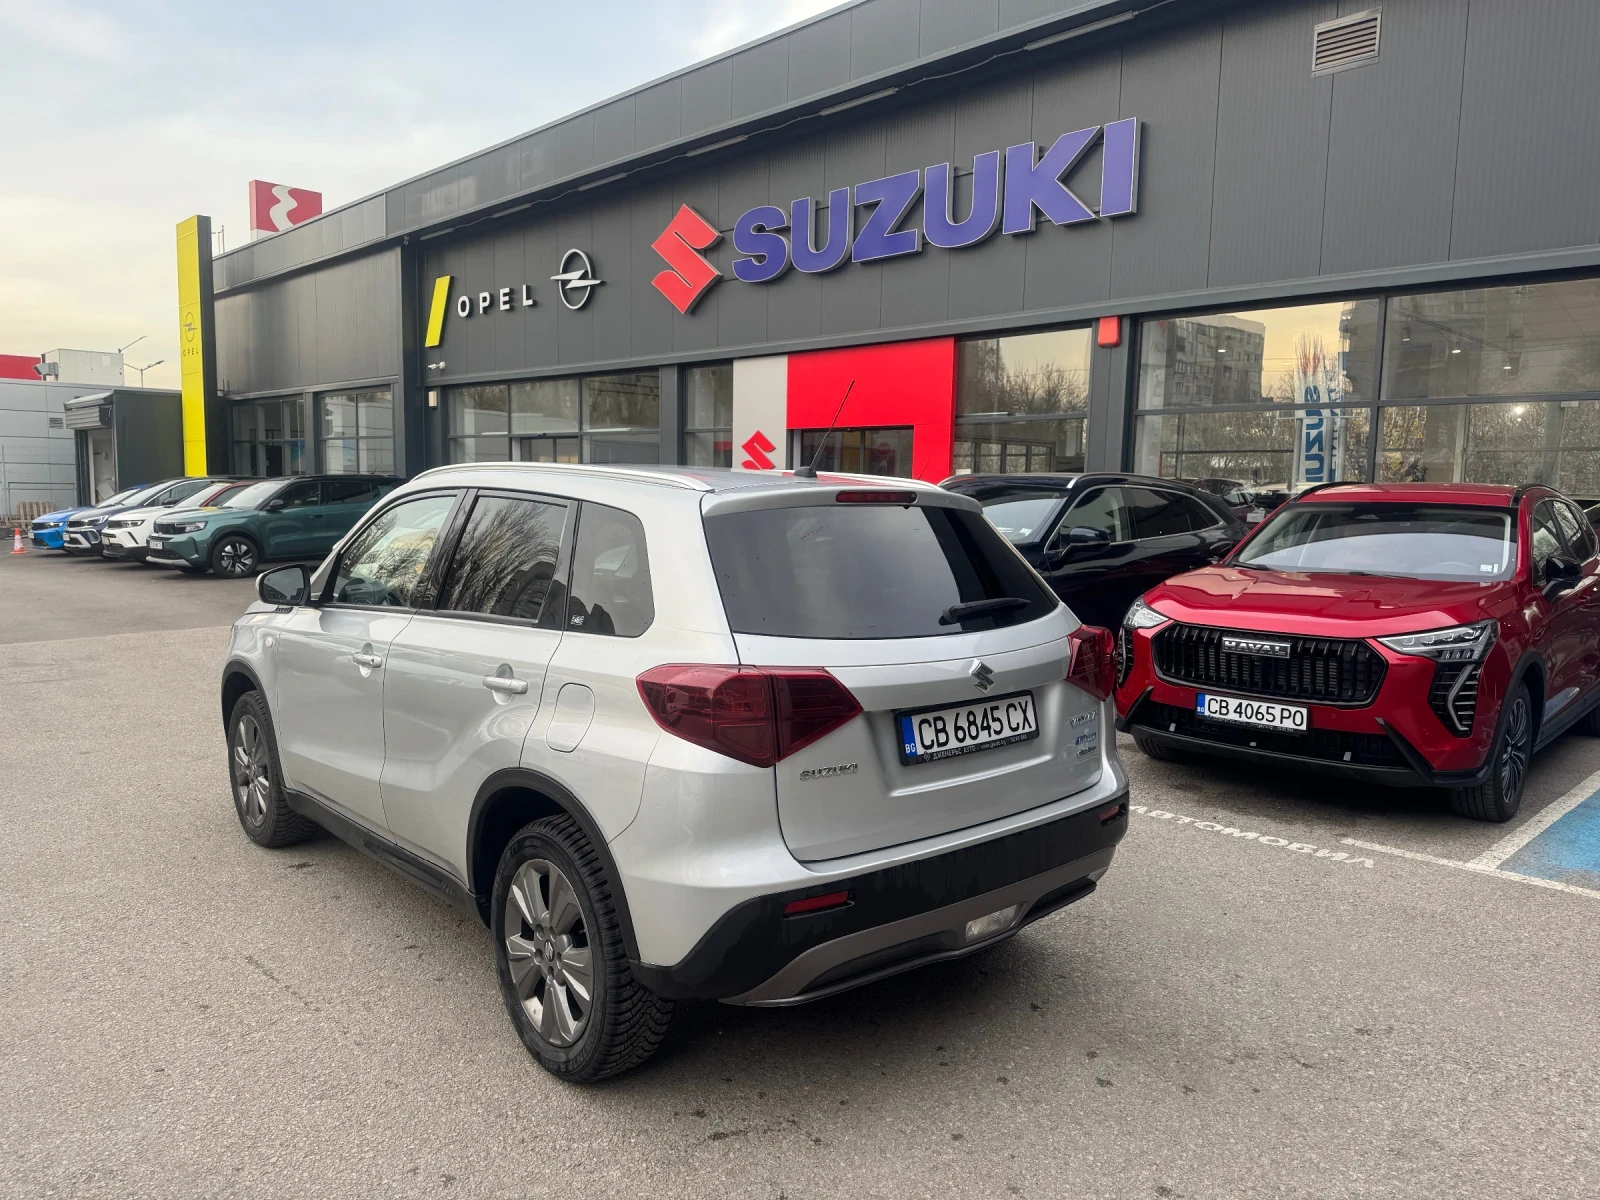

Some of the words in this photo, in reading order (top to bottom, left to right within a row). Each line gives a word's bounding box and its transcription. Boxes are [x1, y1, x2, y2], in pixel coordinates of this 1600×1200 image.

[732, 117, 1139, 283] SUZUKI
[457, 284, 534, 317] OPEL
[182, 347, 199, 357] OPEL
[1224, 641, 1286, 656] HAVAL
[1207, 698, 1230, 716] CB
[1233, 702, 1276, 723] 4065
[918, 715, 950, 750] CB
[954, 705, 1004, 743] 6845
[1005, 700, 1032, 732] CX
[904, 743, 916, 754] BG
[799, 762, 858, 781] SUZUKI
